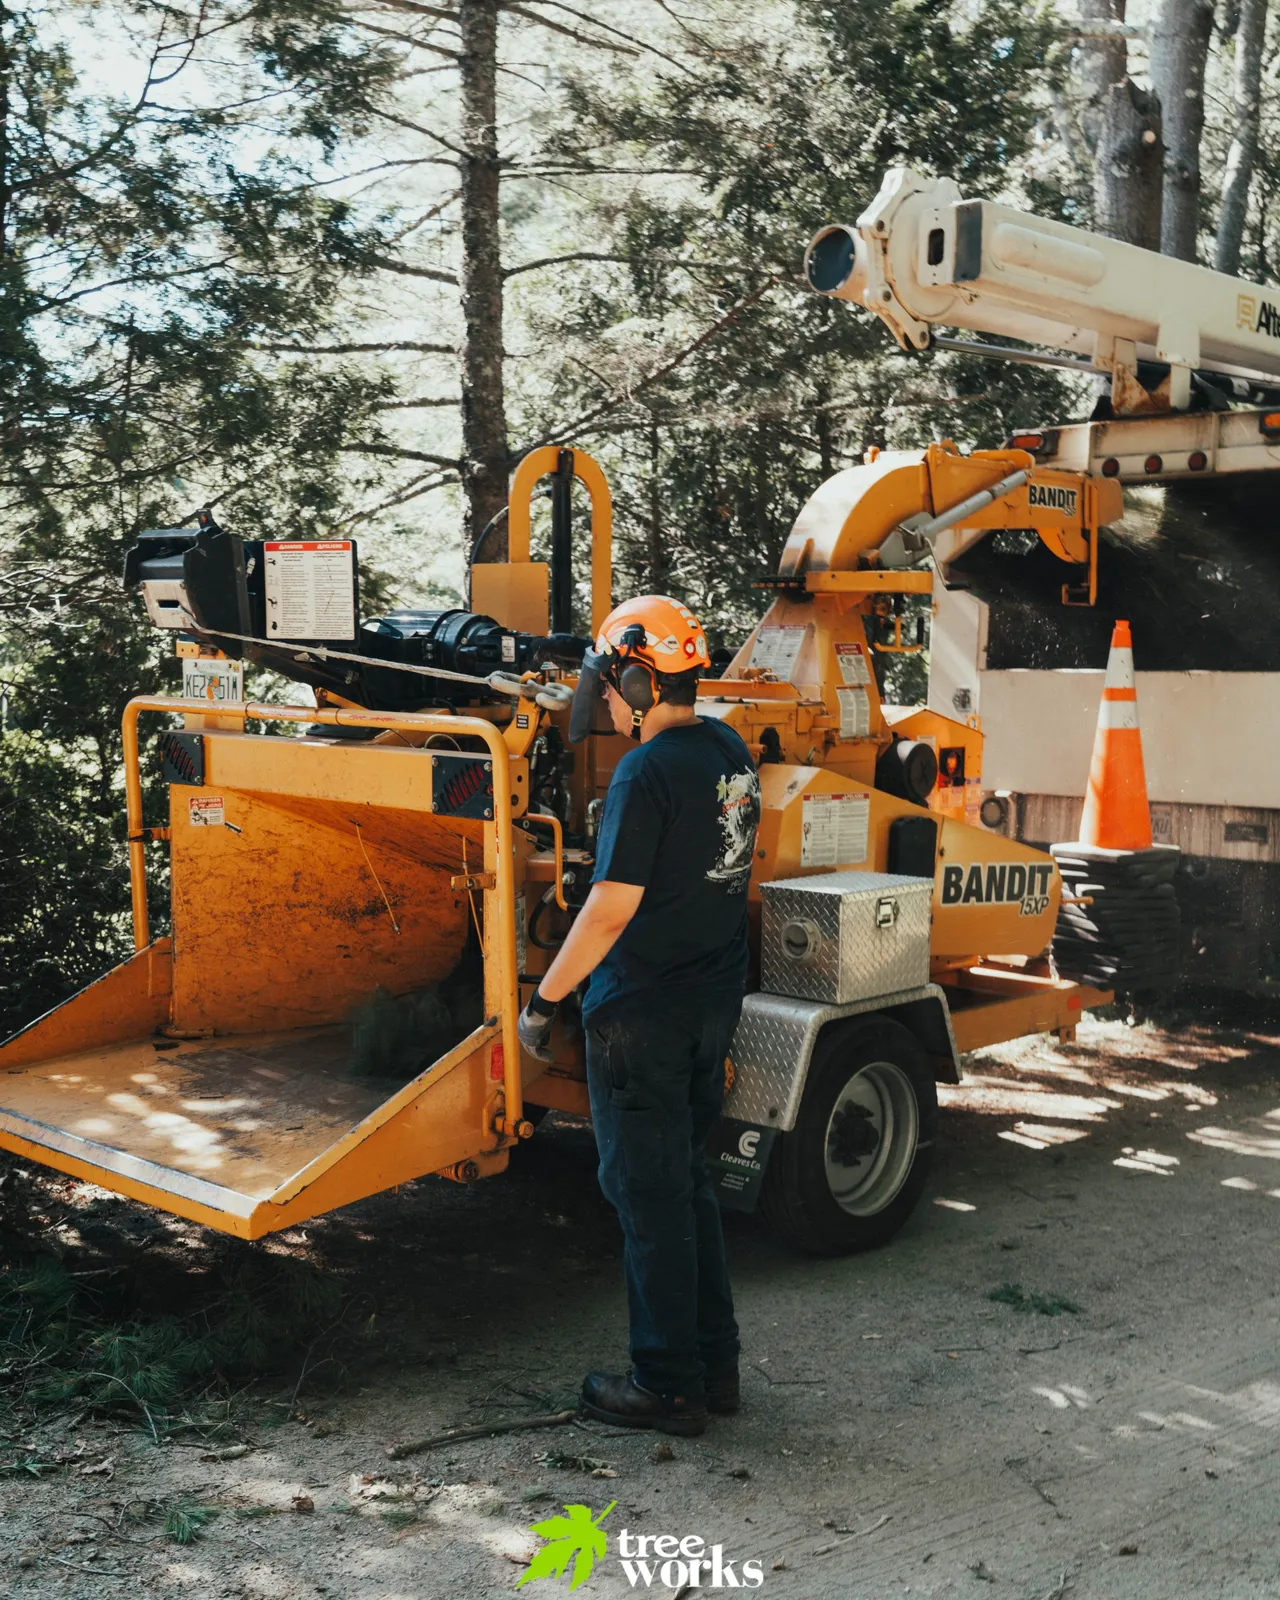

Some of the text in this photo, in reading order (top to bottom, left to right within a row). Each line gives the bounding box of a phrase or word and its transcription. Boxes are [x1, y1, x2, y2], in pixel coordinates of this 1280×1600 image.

[1256, 300, 1280, 338] Alt
[1028, 484, 1077, 509] BANDIT
[941, 864, 1054, 905] BANDIT
[1019, 897, 1050, 916] 15XP
[720, 1152, 761, 1171] Cleaves Co.
